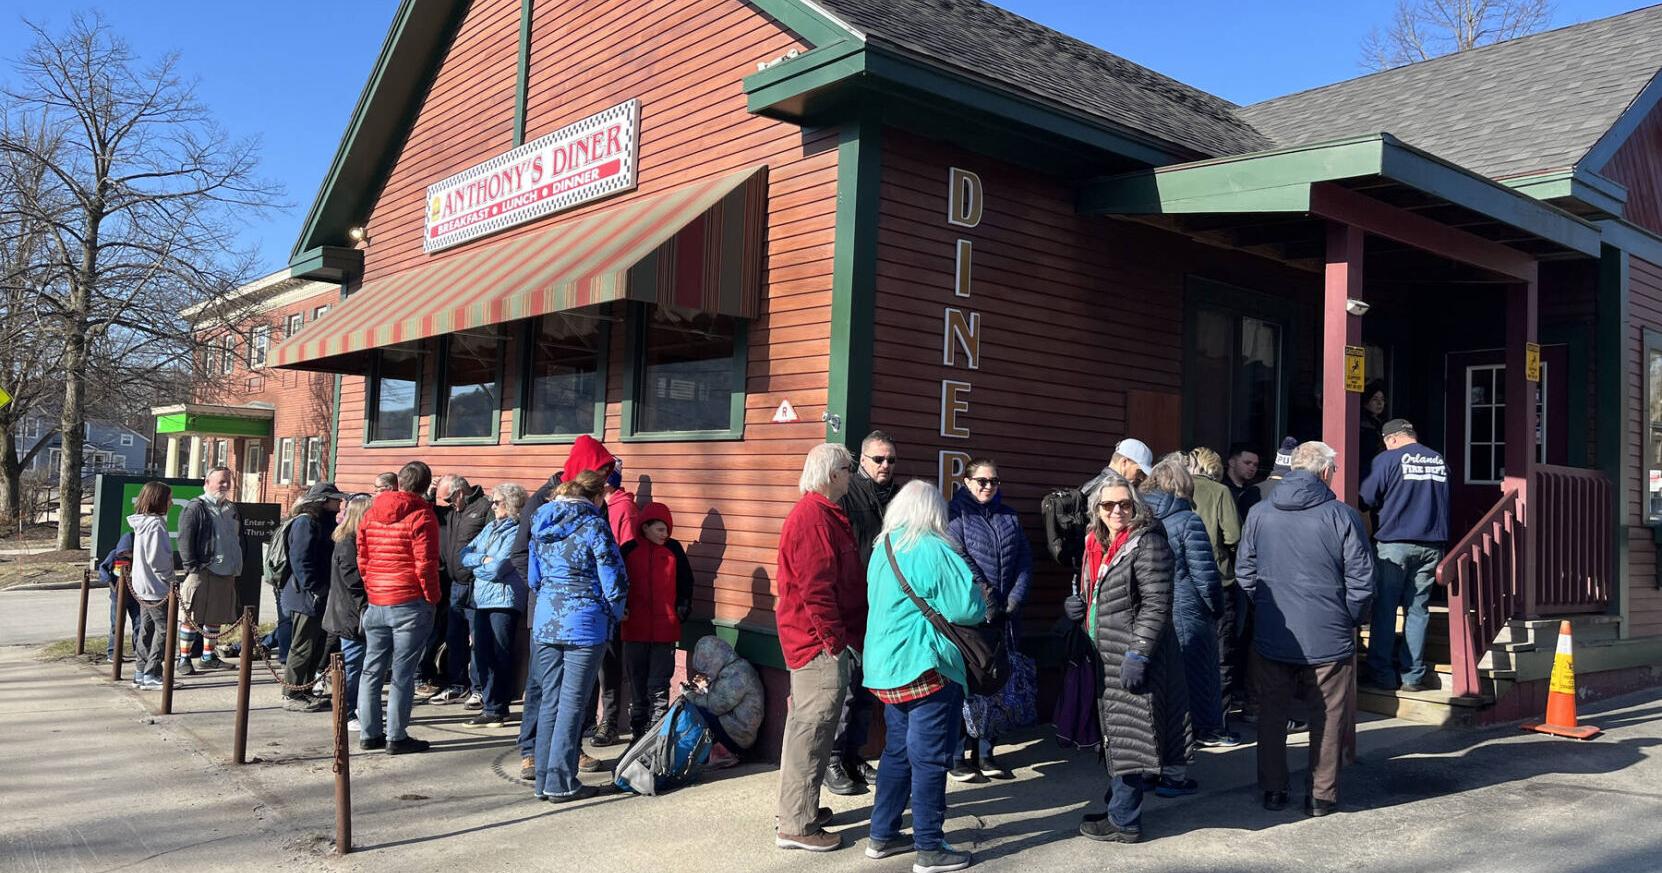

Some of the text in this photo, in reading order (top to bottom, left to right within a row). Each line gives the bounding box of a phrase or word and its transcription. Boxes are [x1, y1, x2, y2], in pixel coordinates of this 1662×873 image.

[441, 123, 623, 219] ANTHONY'S DINER
[437, 167, 600, 234] BREAKFAST LUNCH DINNER
[938, 166, 984, 500] DINER
[782, 406, 788, 417] R
[1401, 453, 1444, 465] Orlando
[1401, 464, 1447, 476] FIRE DEPT.
[244, 518, 266, 526] Enter
